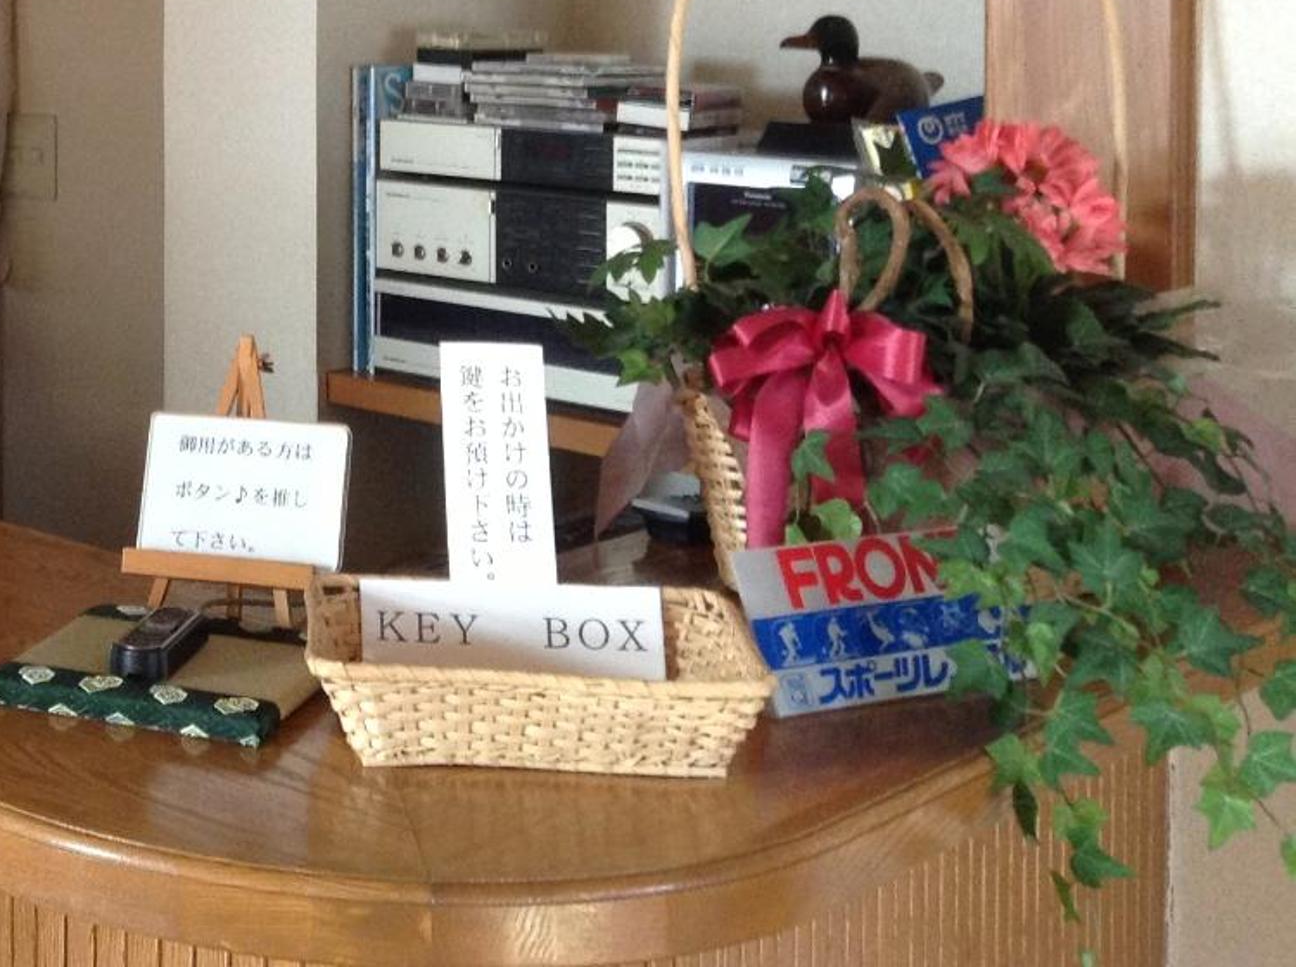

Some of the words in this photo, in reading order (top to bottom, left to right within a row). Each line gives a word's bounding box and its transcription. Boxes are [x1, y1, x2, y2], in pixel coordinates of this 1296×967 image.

[179, 434, 312, 460] 御用がある方は
[460, 365, 496, 581] 鍵をお預け下さい。
[501, 365, 533, 543] お出かけの時は
[172, 531, 256, 553] て下さい。
[776, 528, 954, 609] FRON
[377, 610, 479, 645] KEY
[543, 616, 648, 652] BOX
